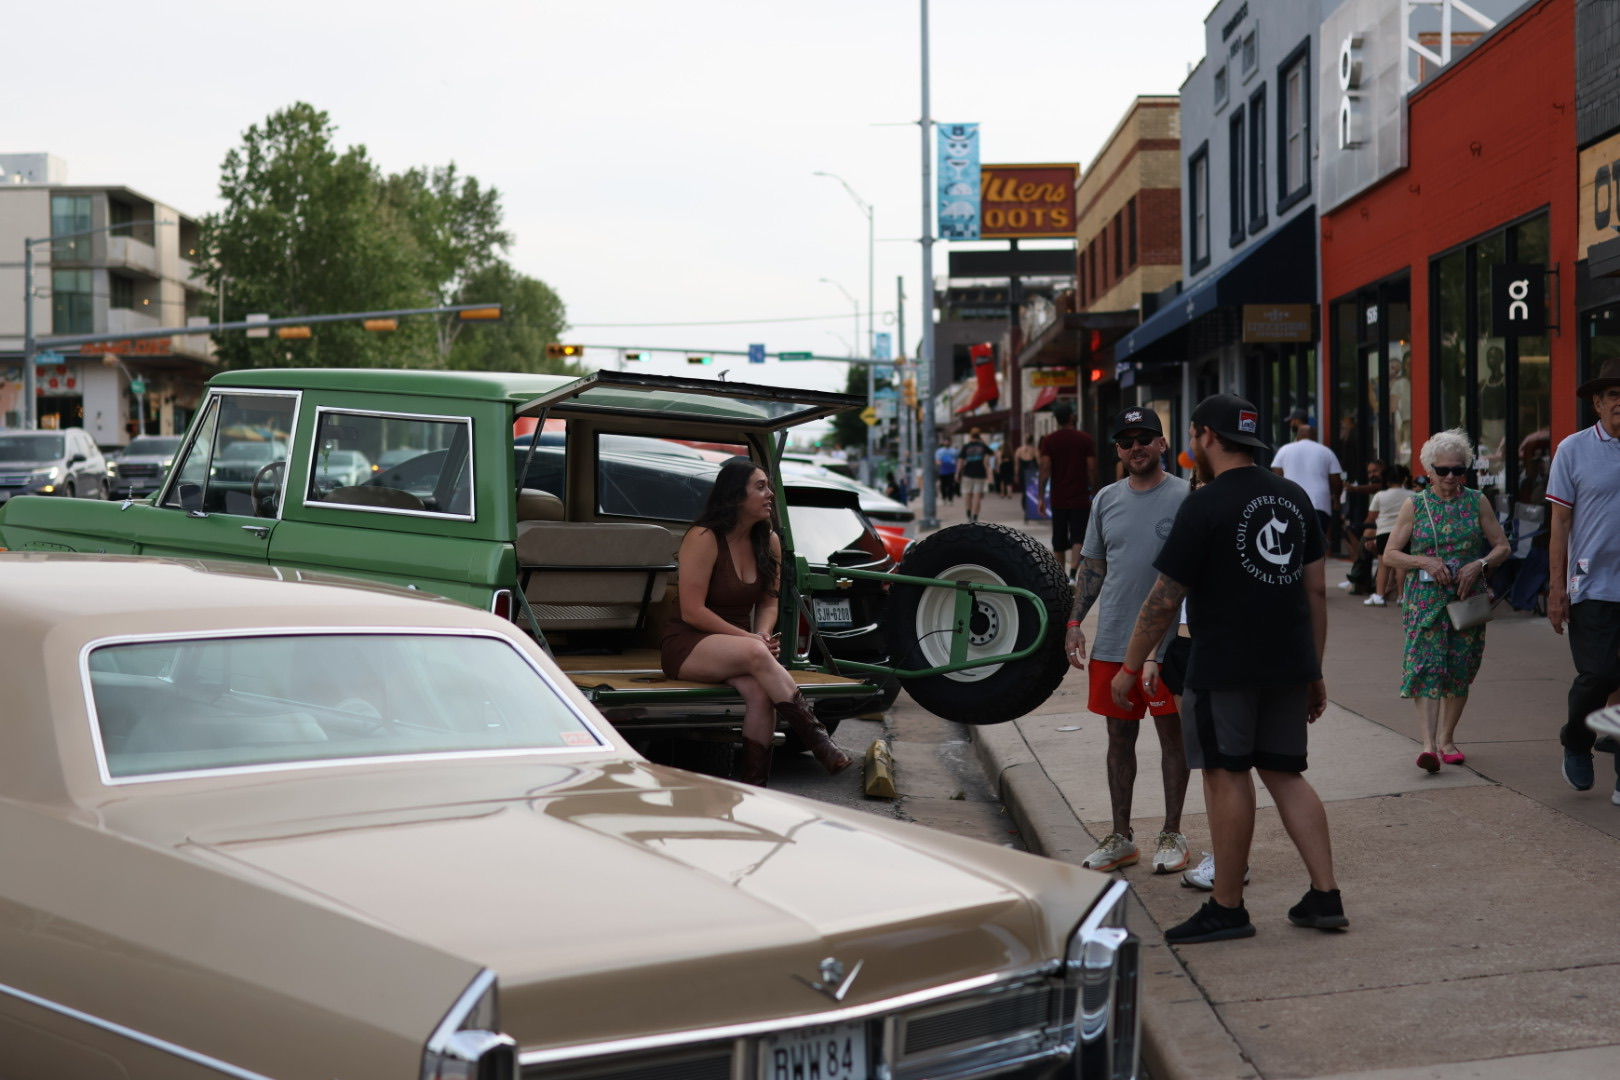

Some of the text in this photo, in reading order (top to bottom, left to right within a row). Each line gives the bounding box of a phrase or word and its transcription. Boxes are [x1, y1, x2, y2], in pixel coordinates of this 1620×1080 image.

[984, 207, 1070, 229] OOTS
[1242, 495, 1277, 519] COFFEE
[1236, 521, 1249, 550] COIL
[1241, 559, 1275, 584] LOYAL
[1277, 575, 1292, 585] TO
